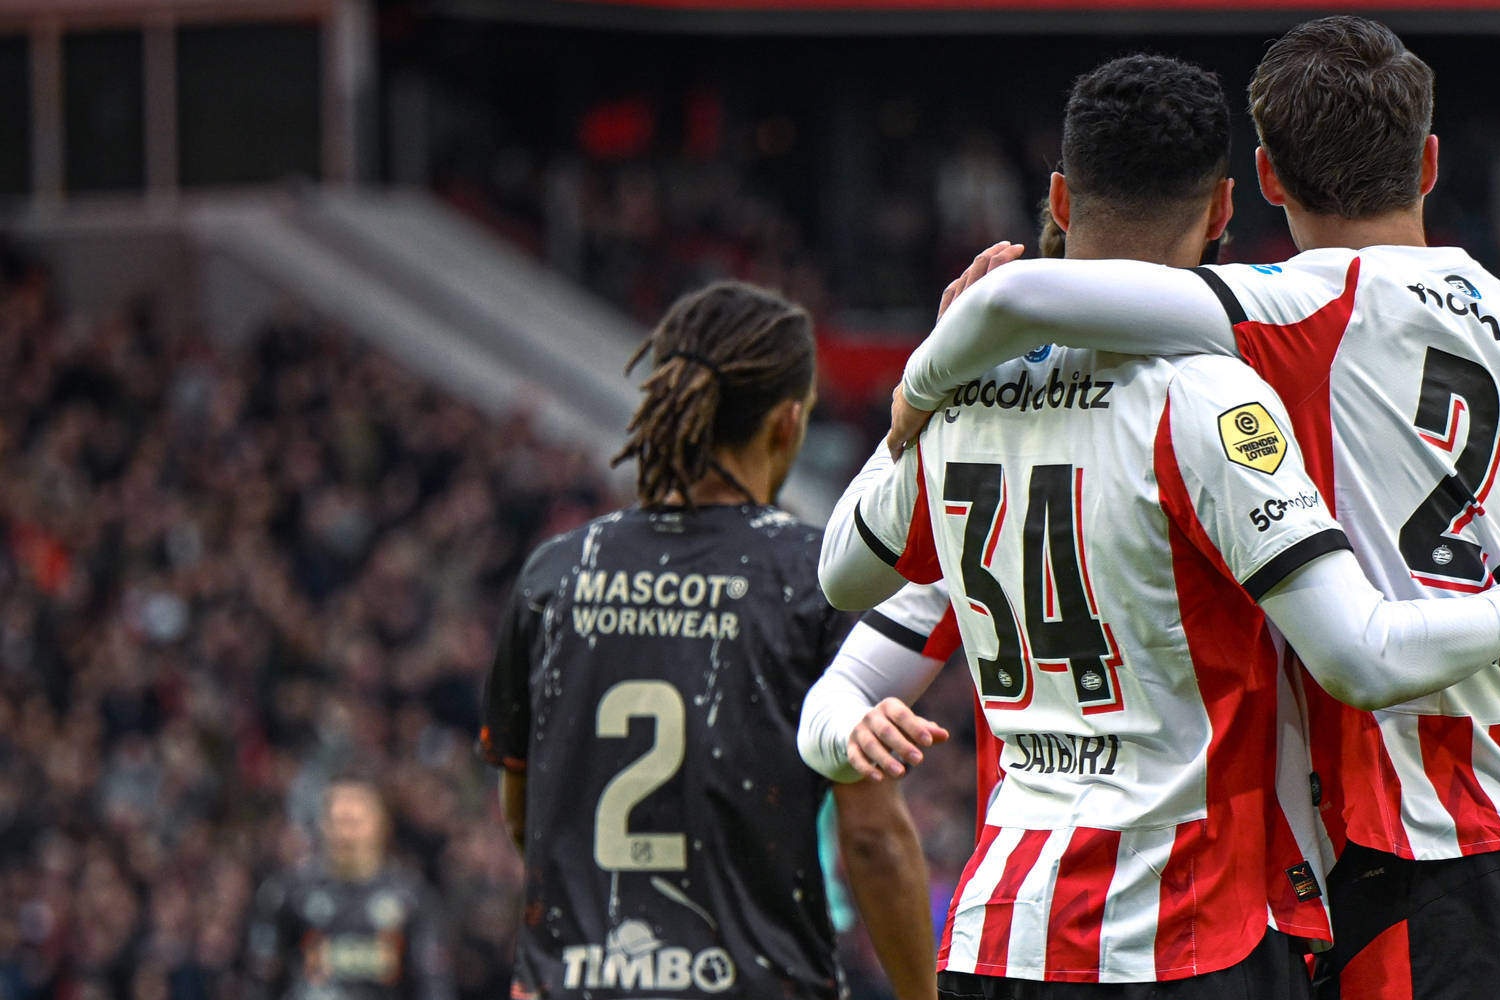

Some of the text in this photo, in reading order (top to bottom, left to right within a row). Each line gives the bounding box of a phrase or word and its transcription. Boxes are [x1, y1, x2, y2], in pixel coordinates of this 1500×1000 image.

[1235, 435, 1280, 454] VRIENDEN
[1246, 446, 1278, 461] LOTERIJ
[943, 461, 1124, 715] 34
[572, 604, 740, 641] WORKWEAR
[594, 679, 687, 871] 2
[562, 945, 736, 994] TIMBO
